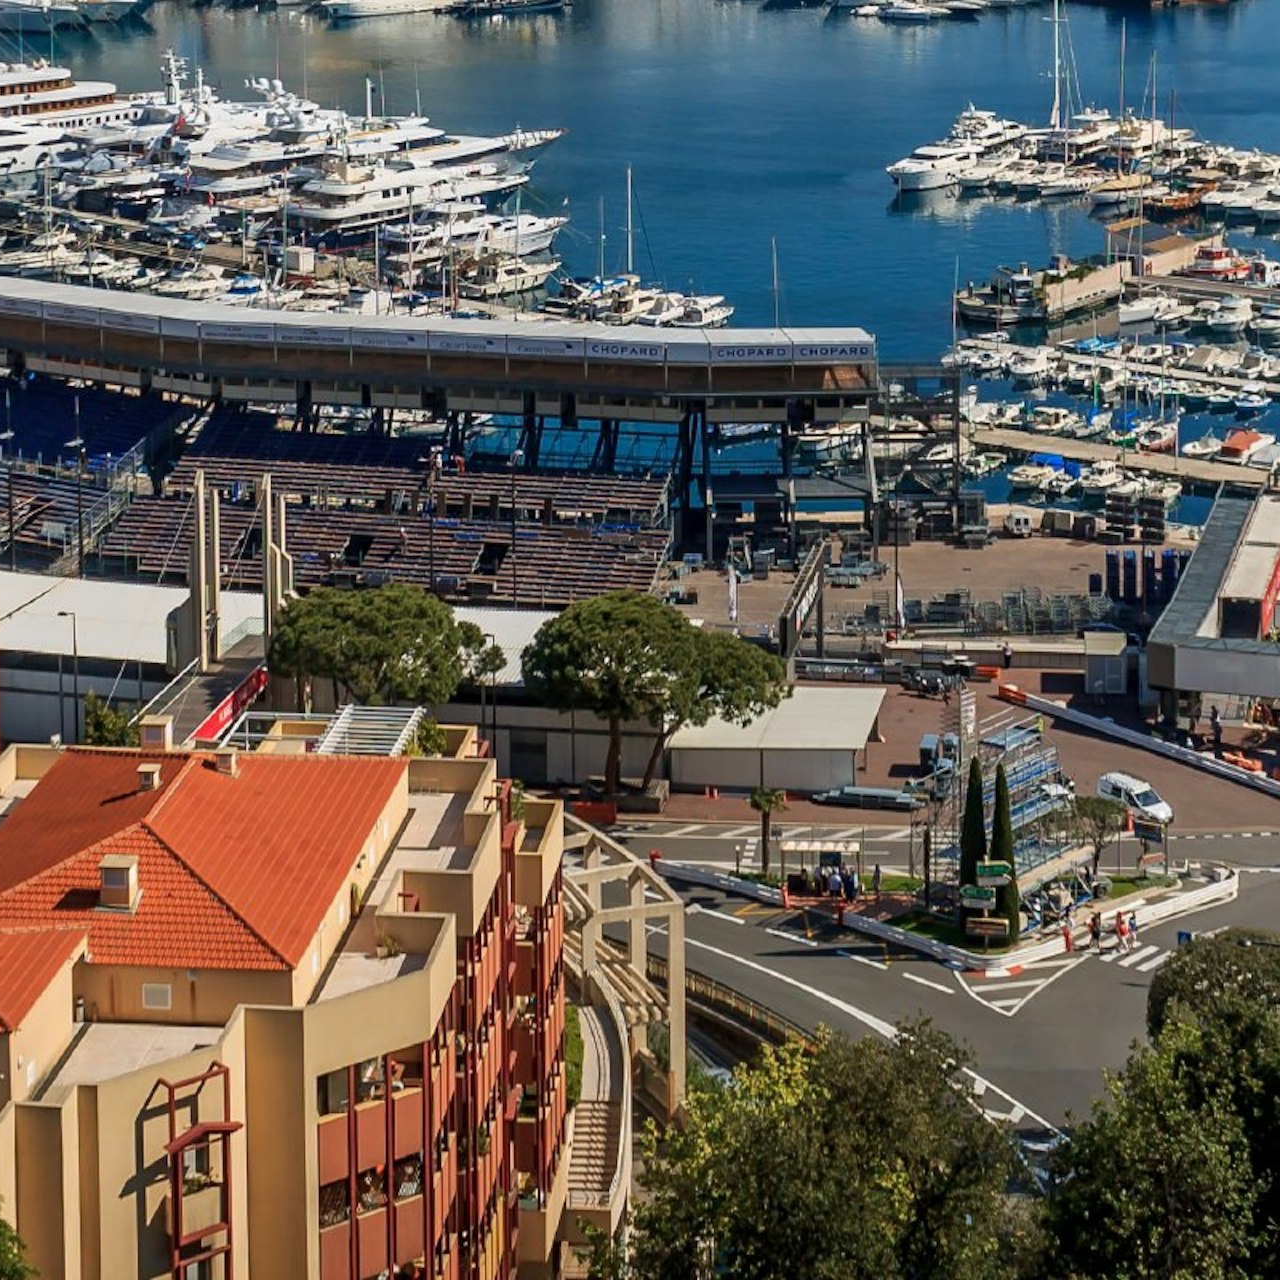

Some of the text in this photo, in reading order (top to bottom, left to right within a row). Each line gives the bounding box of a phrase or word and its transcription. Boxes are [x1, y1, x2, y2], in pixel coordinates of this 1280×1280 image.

[591, 344, 659, 356] CHOPARD
[717, 348, 787, 358] CHOPARD
[799, 346, 869, 357] CHOPARD
